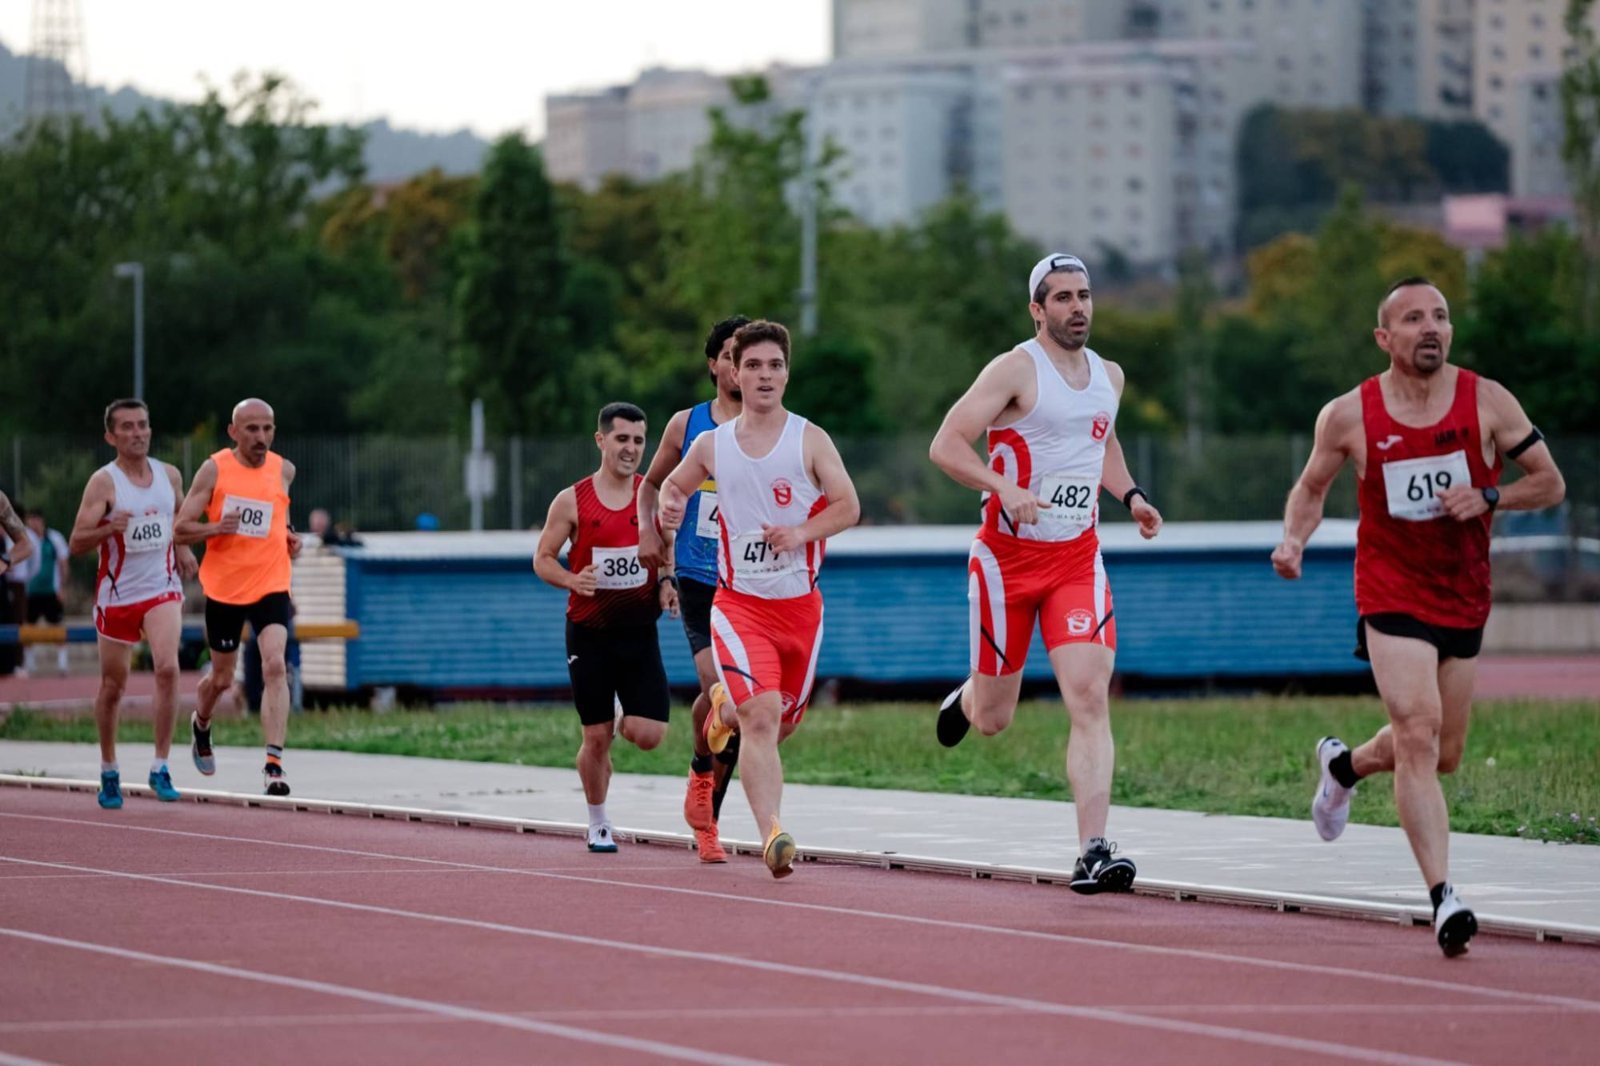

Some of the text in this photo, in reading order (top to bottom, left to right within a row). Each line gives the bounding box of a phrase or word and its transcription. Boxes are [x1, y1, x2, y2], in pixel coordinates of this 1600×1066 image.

[1050, 484, 1091, 508] 482
[1407, 470, 1452, 501] 619
[235, 506, 263, 526] 08
[132, 523, 162, 541] 488
[604, 556, 640, 577] 386
